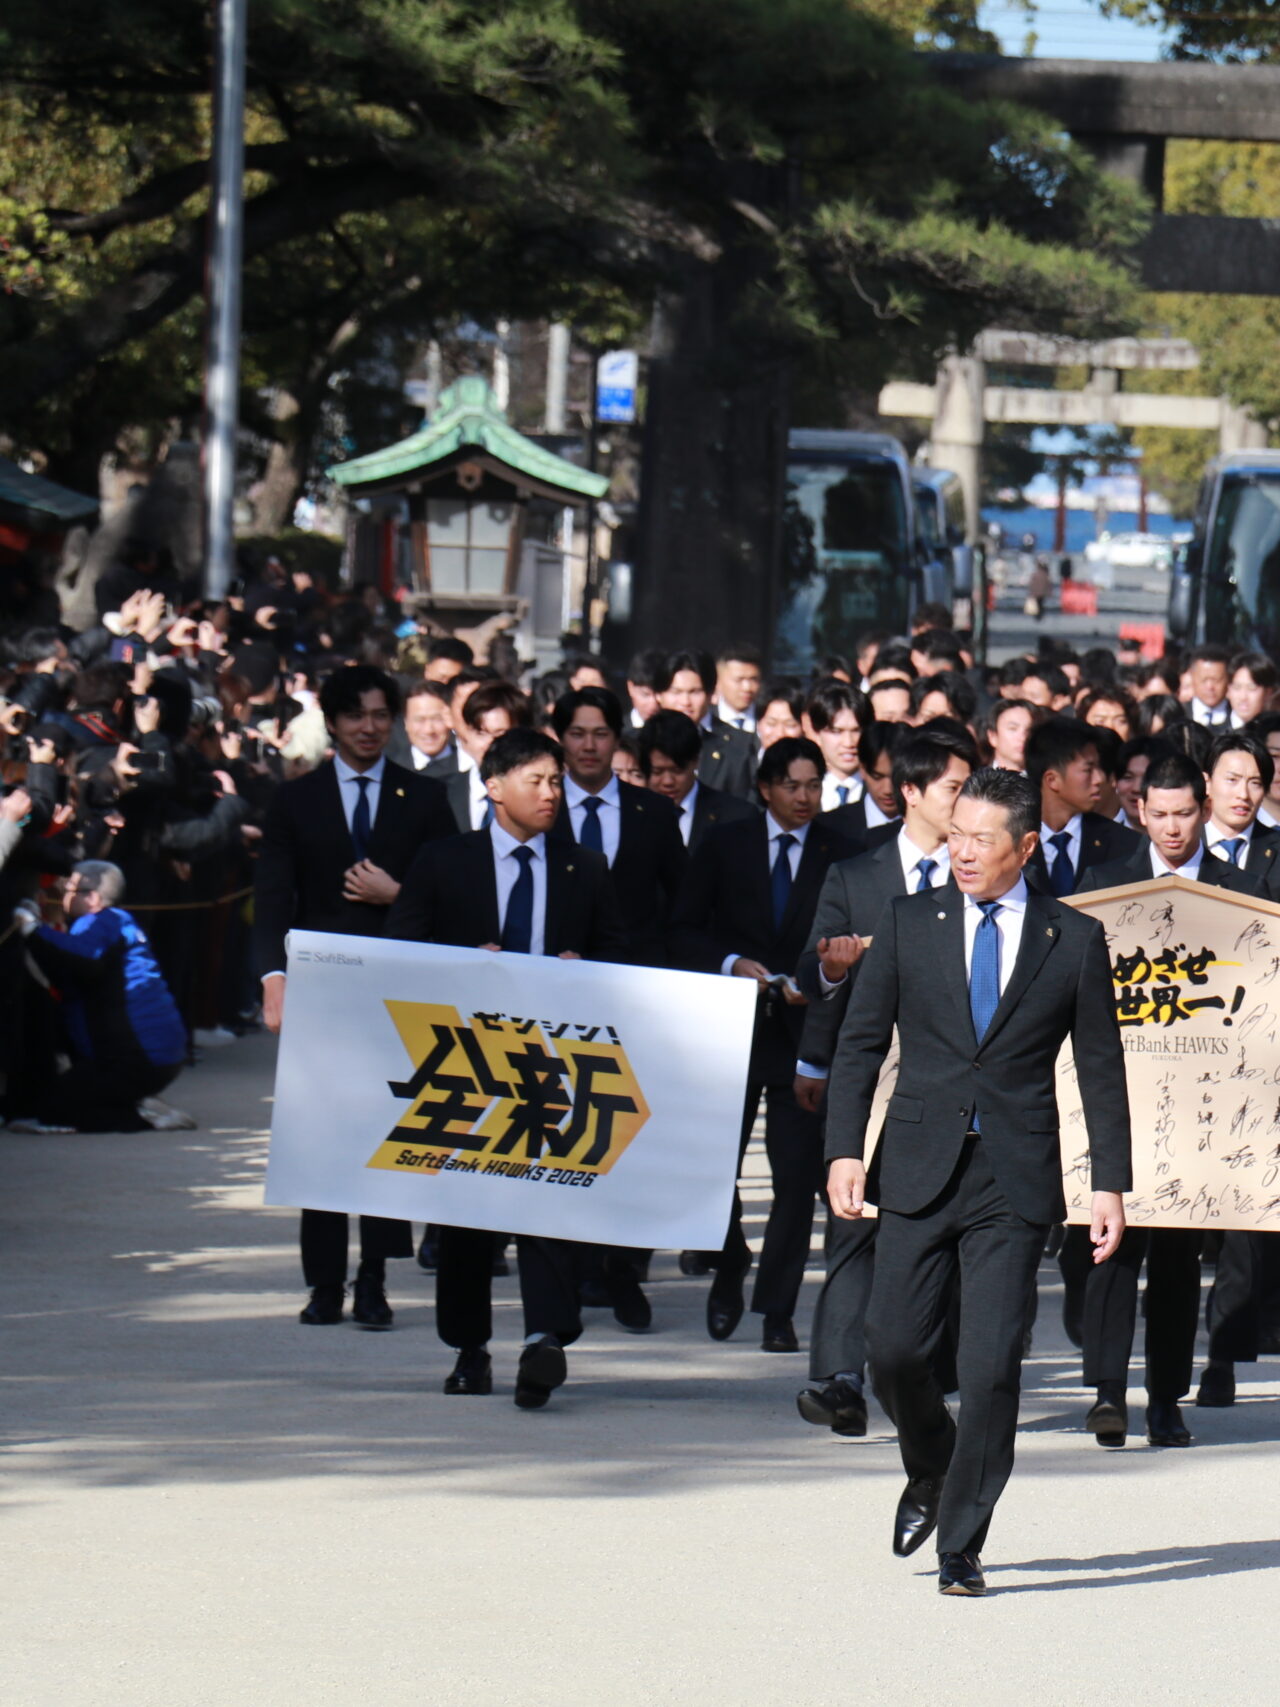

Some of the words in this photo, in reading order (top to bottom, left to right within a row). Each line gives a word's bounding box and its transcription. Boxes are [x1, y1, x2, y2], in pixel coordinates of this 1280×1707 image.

[313, 952, 364, 967] SoftBank
[1112, 943, 1217, 985] めざせ
[472, 1011, 622, 1046] ゼンシン!
[1173, 1035, 1230, 1056] HAWKS
[386, 1023, 640, 1167] 全新
[395, 1149, 483, 1174] SoftBank
[481, 1159, 548, 1182] HAWKS
[545, 1168, 598, 1188] 2026
